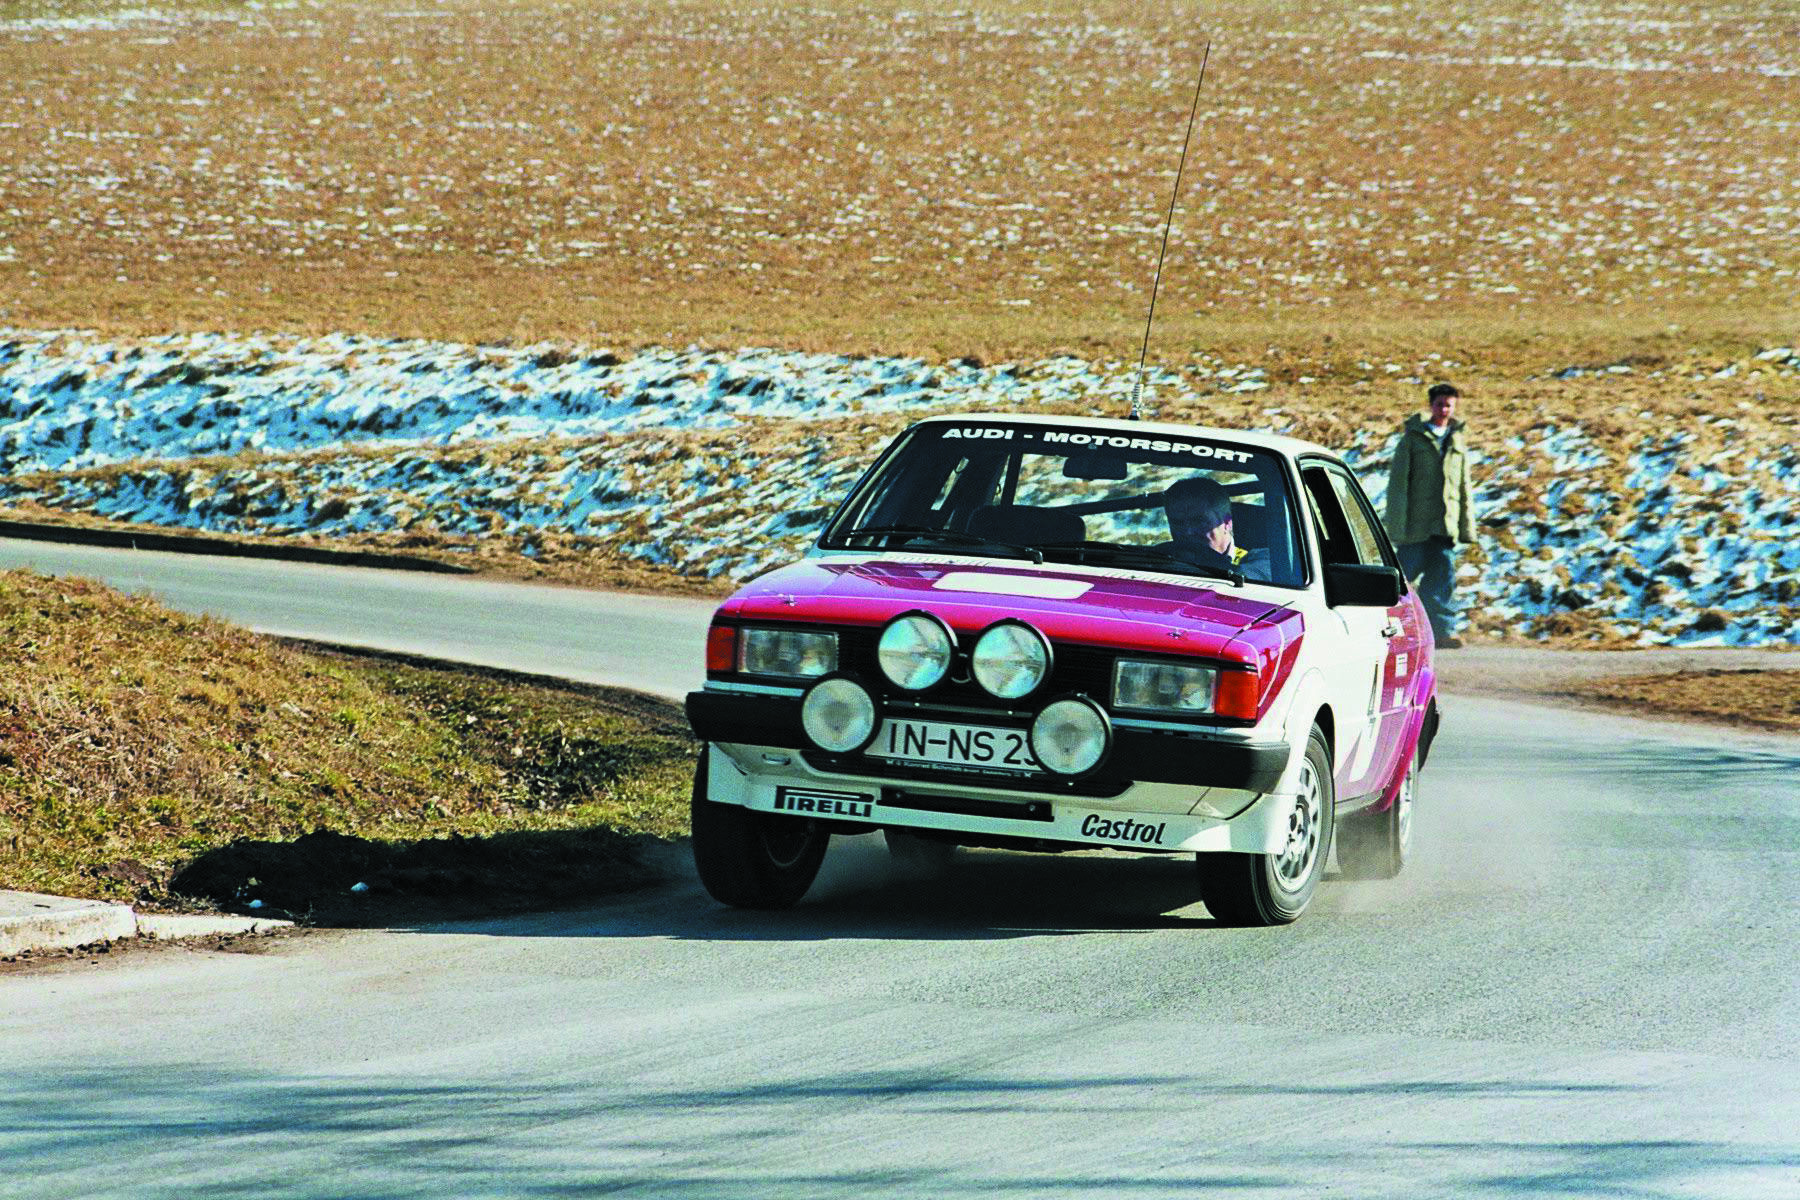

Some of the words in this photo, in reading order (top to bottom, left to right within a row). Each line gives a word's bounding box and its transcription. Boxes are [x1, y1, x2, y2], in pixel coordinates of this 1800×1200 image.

[942, 428, 1014, 440] AUDI
[1043, 431, 1254, 463] MOTORSPORT
[890, 723, 995, 762] IN-NS
[774, 785, 875, 818] PIRELLI
[1081, 814, 1166, 845] Castrol
